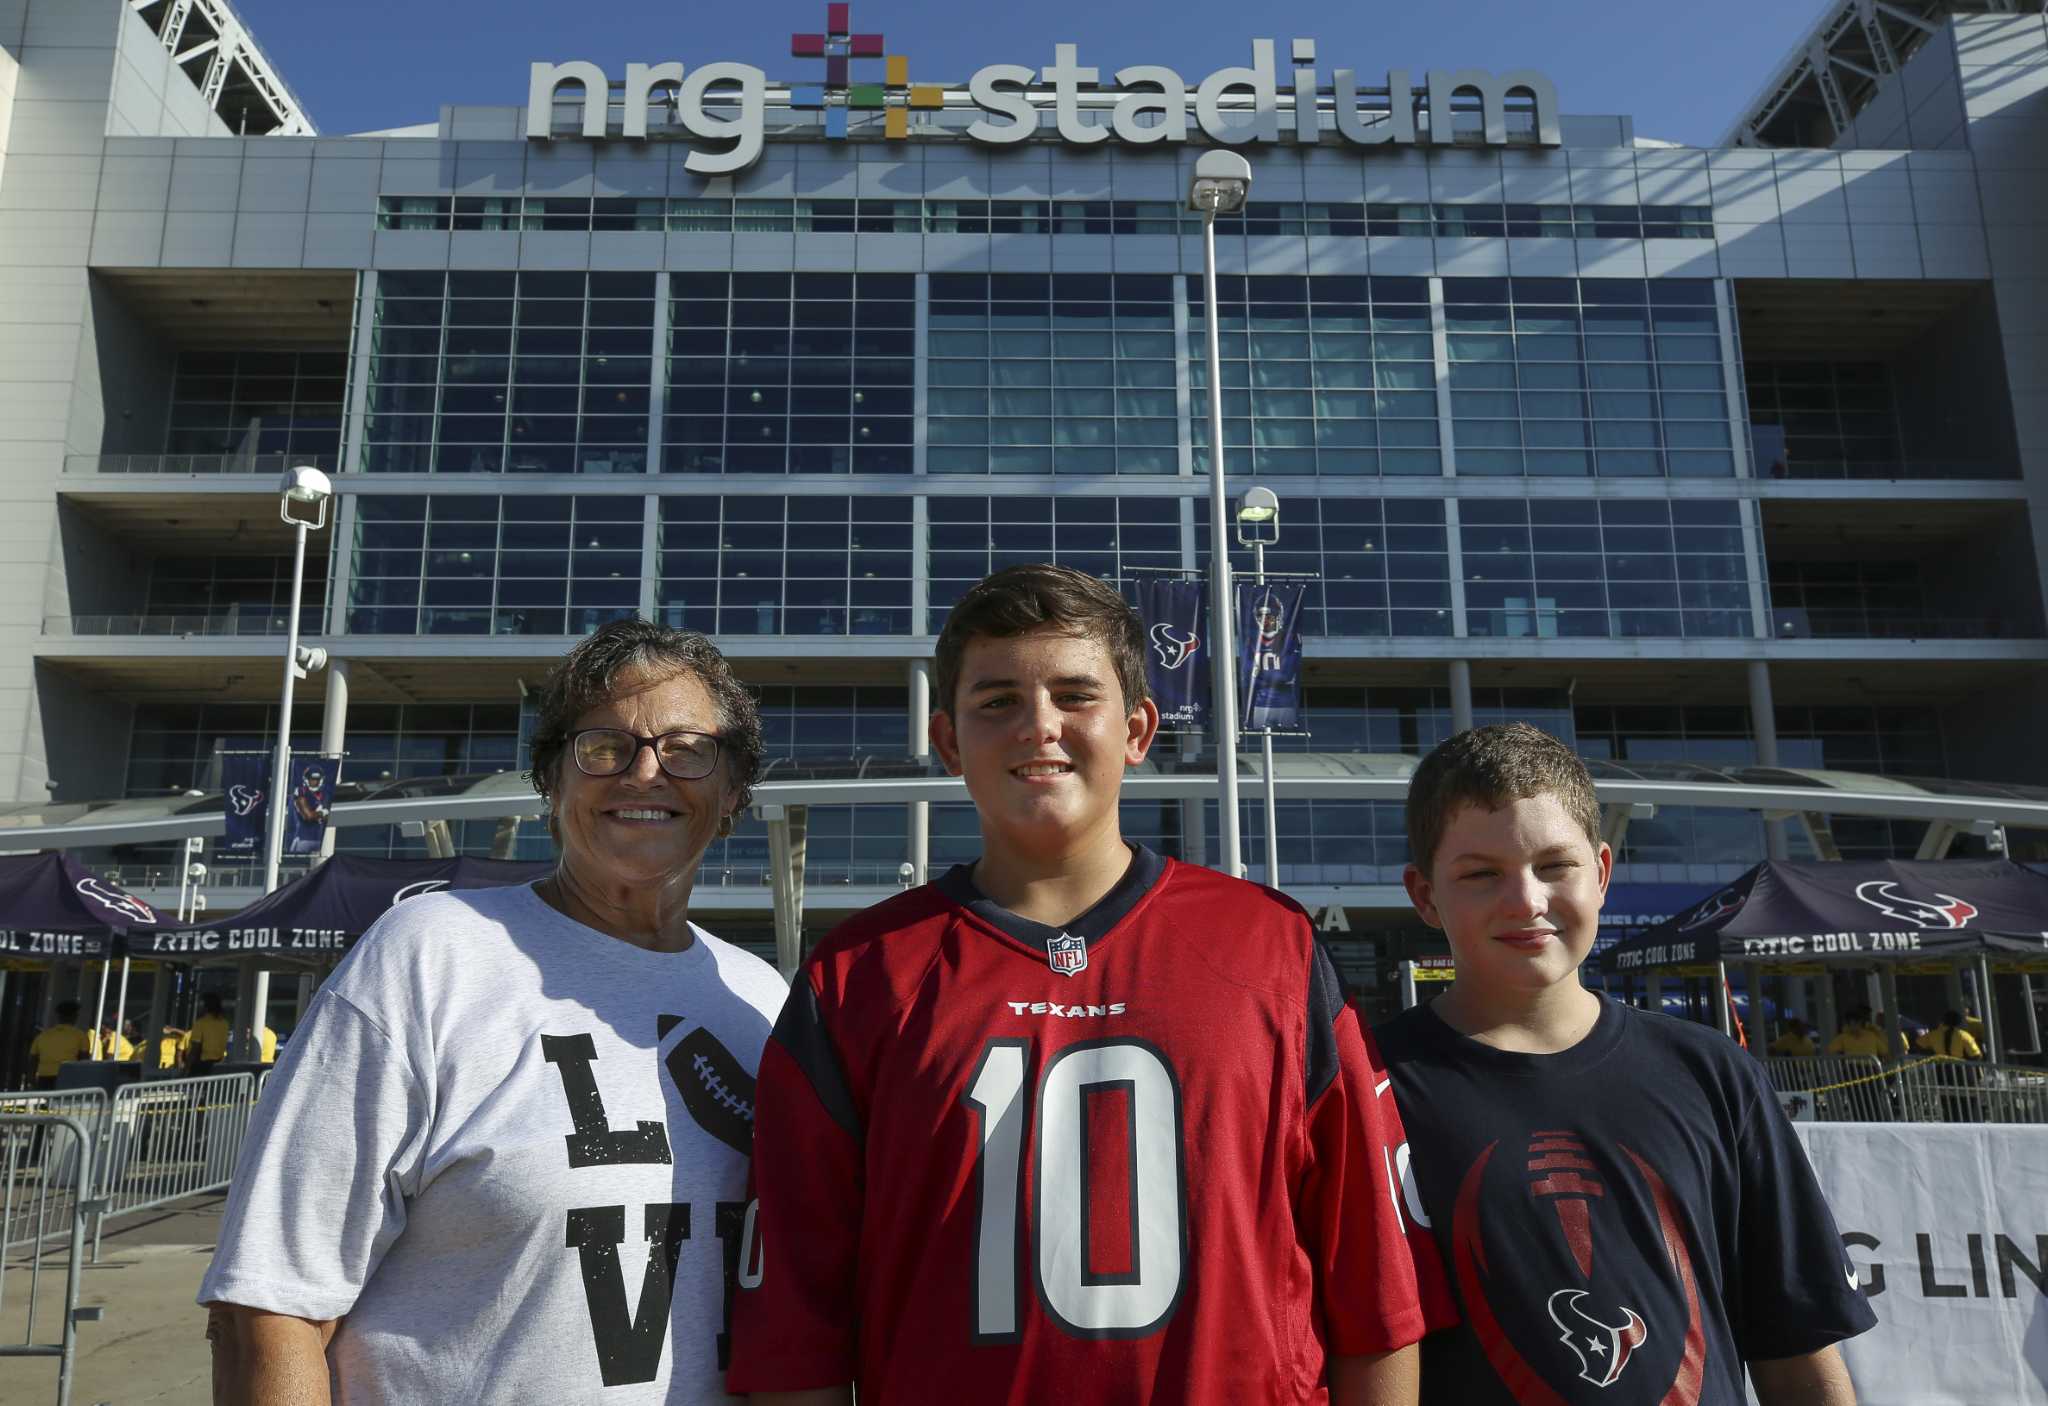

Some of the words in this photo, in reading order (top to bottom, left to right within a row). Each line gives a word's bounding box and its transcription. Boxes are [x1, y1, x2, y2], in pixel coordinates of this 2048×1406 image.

[527, 60, 766, 174] nrg
[966, 38, 1562, 149] stadium
[1161, 711, 1194, 721] stadium
[30, 931, 84, 954] ZONE
[228, 927, 282, 949] COOL
[291, 927, 345, 949] ZONE
[1812, 932, 1862, 952] COOL
[1869, 931, 1920, 950] ZONE
[1055, 950, 1082, 968] NFL
[1007, 1001, 1127, 1018] TEXANS
[960, 1036, 1190, 1345] 10
